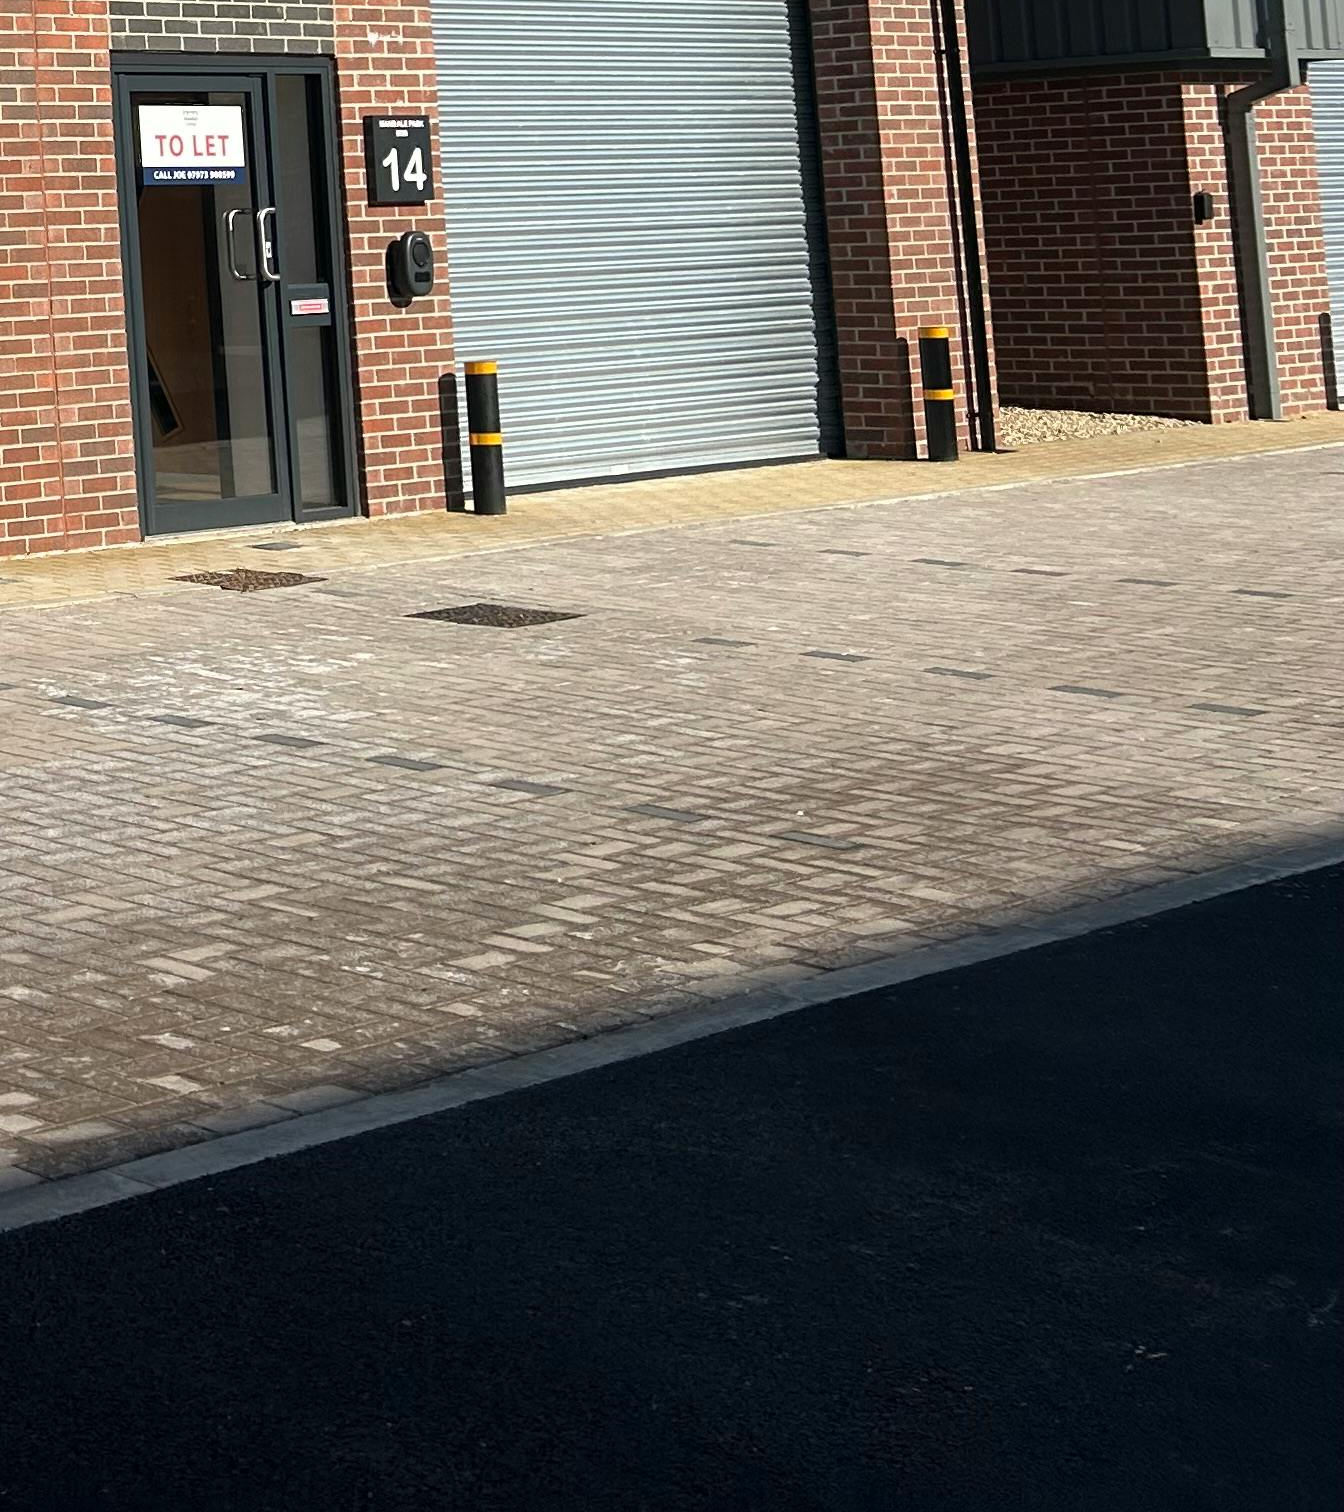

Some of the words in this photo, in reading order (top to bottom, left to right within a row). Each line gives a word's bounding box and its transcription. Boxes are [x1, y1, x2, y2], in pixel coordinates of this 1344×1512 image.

[155, 134, 184, 157] TO
[192, 134, 229, 157] LET
[153, 170, 172, 180] CALL
[382, 148, 427, 191] 14
